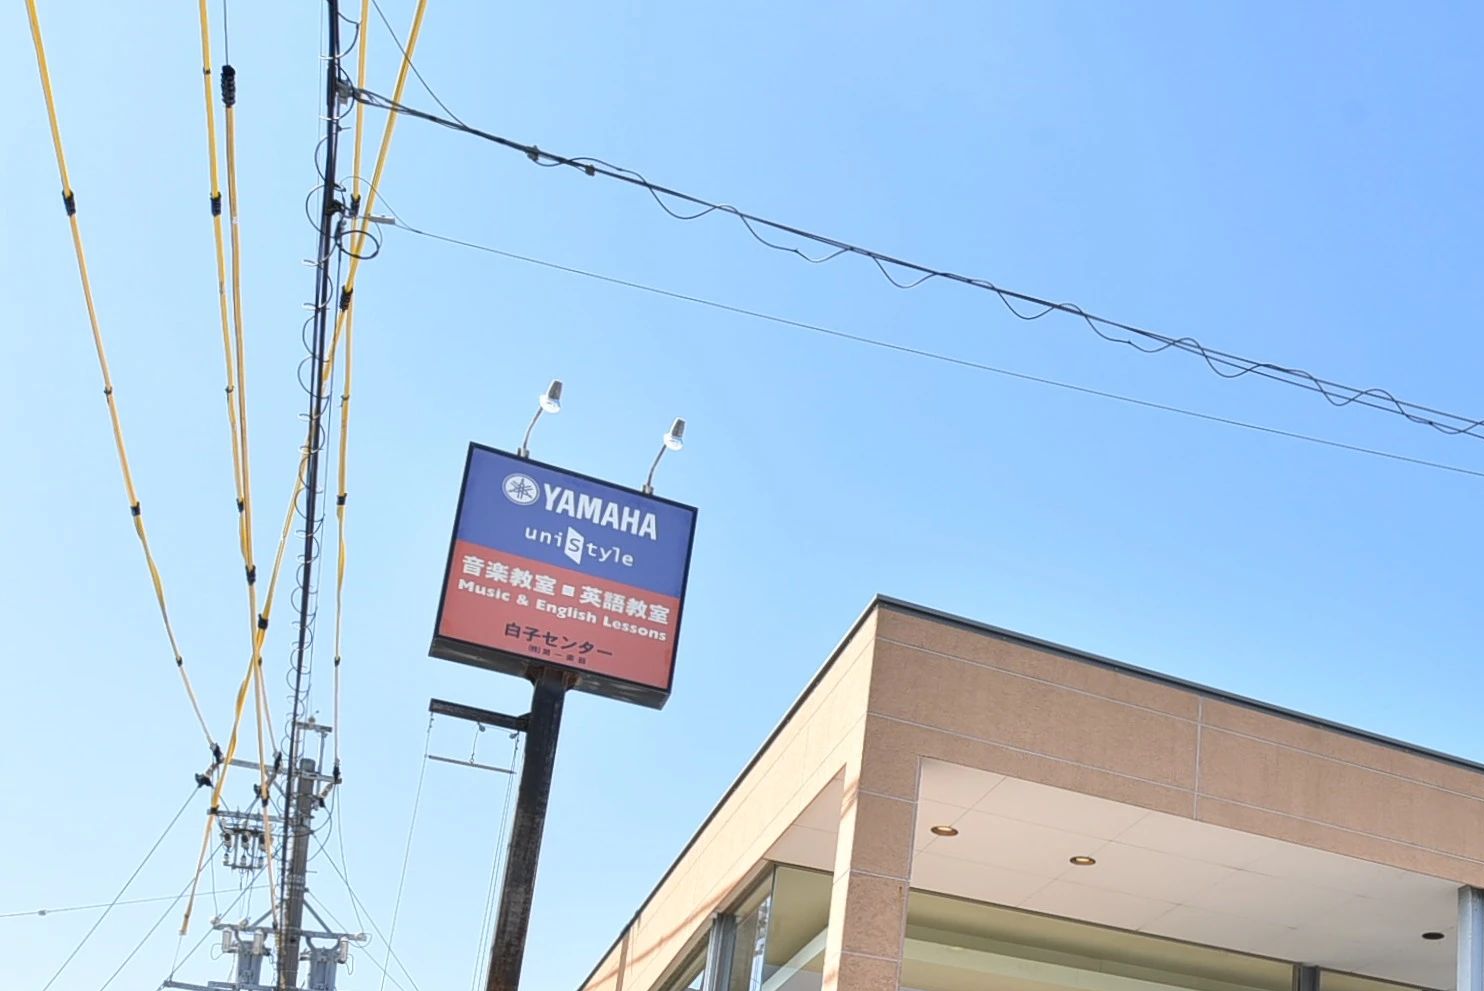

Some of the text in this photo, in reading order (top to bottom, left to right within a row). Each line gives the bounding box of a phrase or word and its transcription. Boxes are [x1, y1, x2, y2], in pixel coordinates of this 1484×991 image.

[544, 482, 657, 540] YAMAHA
[458, 578, 666, 641] Music & English Lessons
[504, 622, 612, 656] 白子センター
